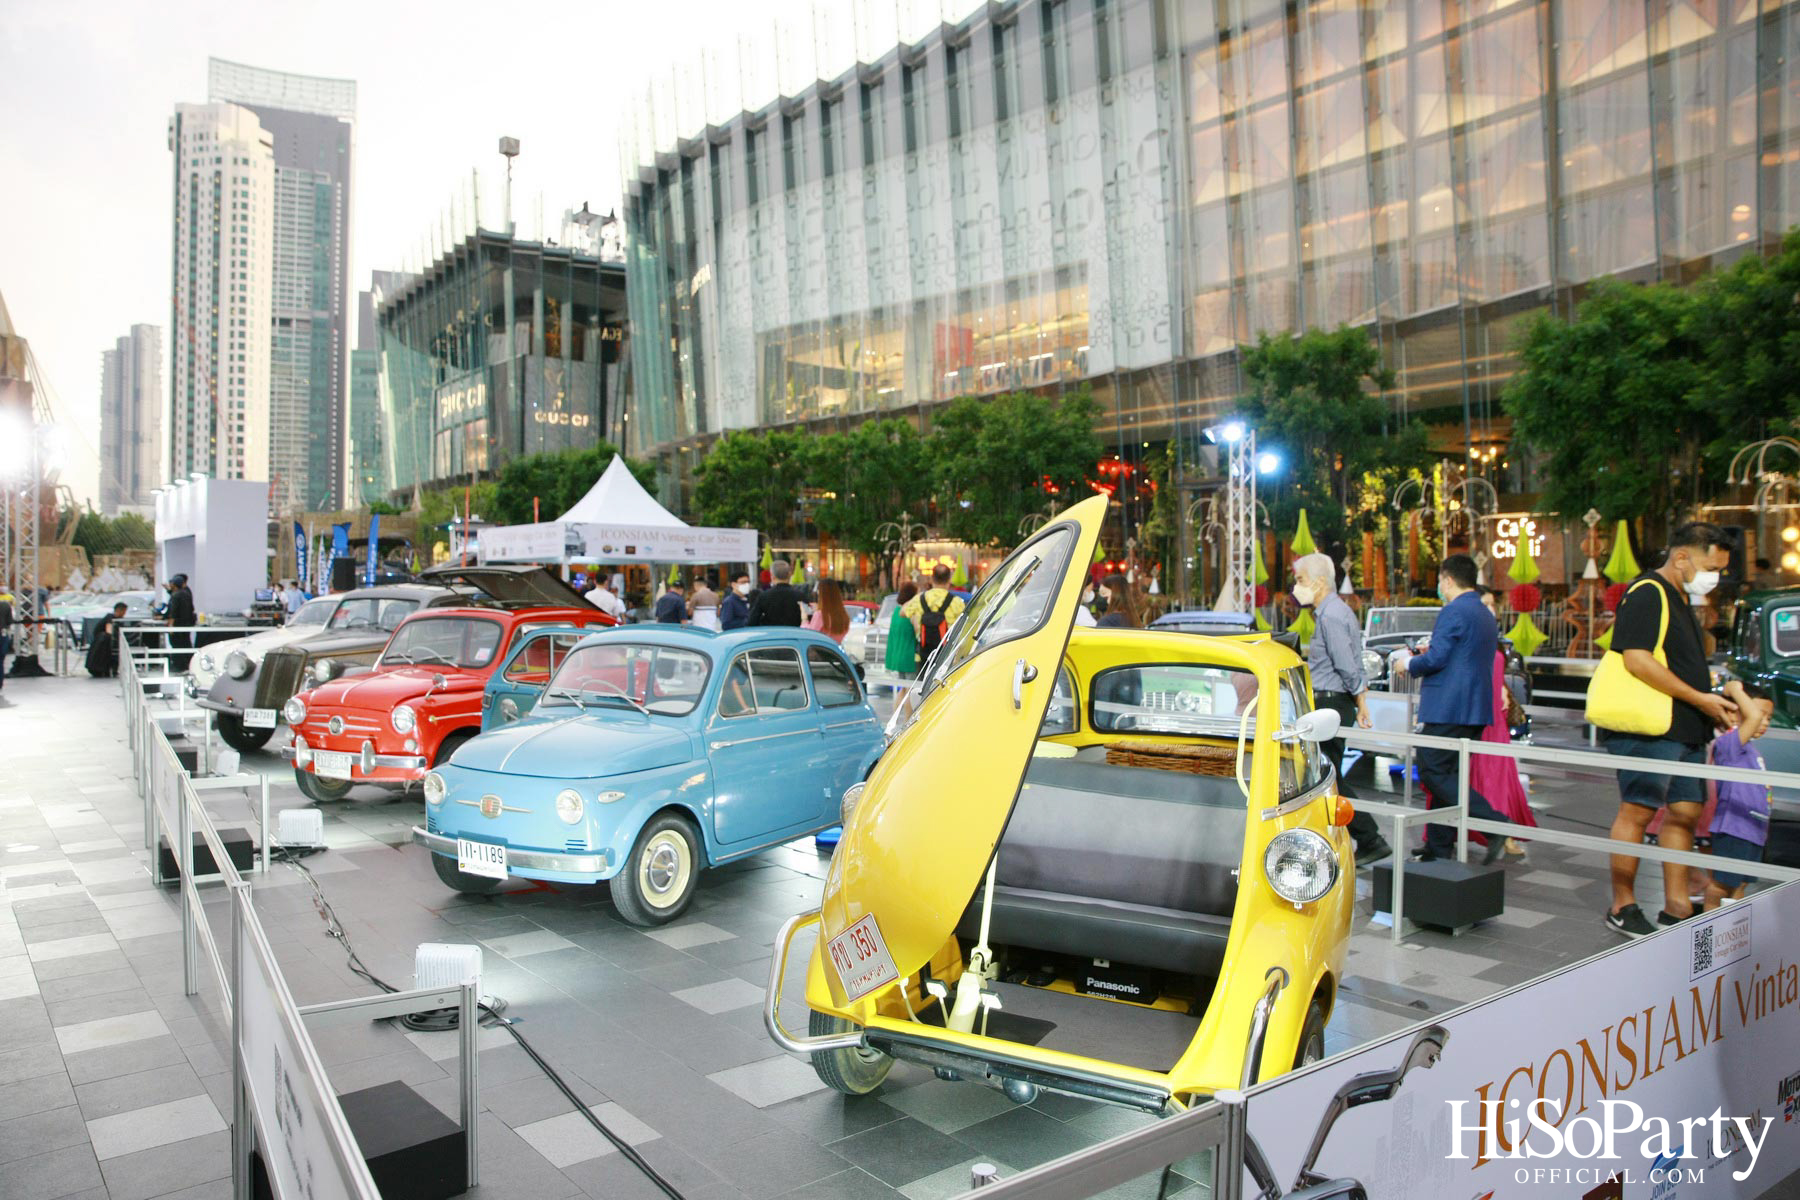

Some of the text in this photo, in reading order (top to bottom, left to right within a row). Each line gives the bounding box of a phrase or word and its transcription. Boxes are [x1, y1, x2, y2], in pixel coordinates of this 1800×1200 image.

[600, 529, 742, 545] ICONSIAM Vintage Car Show
[850, 924, 878, 961] 350
[1086, 976, 1140, 995] Panasonic
[1471, 957, 1800, 1170] ICONSIAM Vinta
